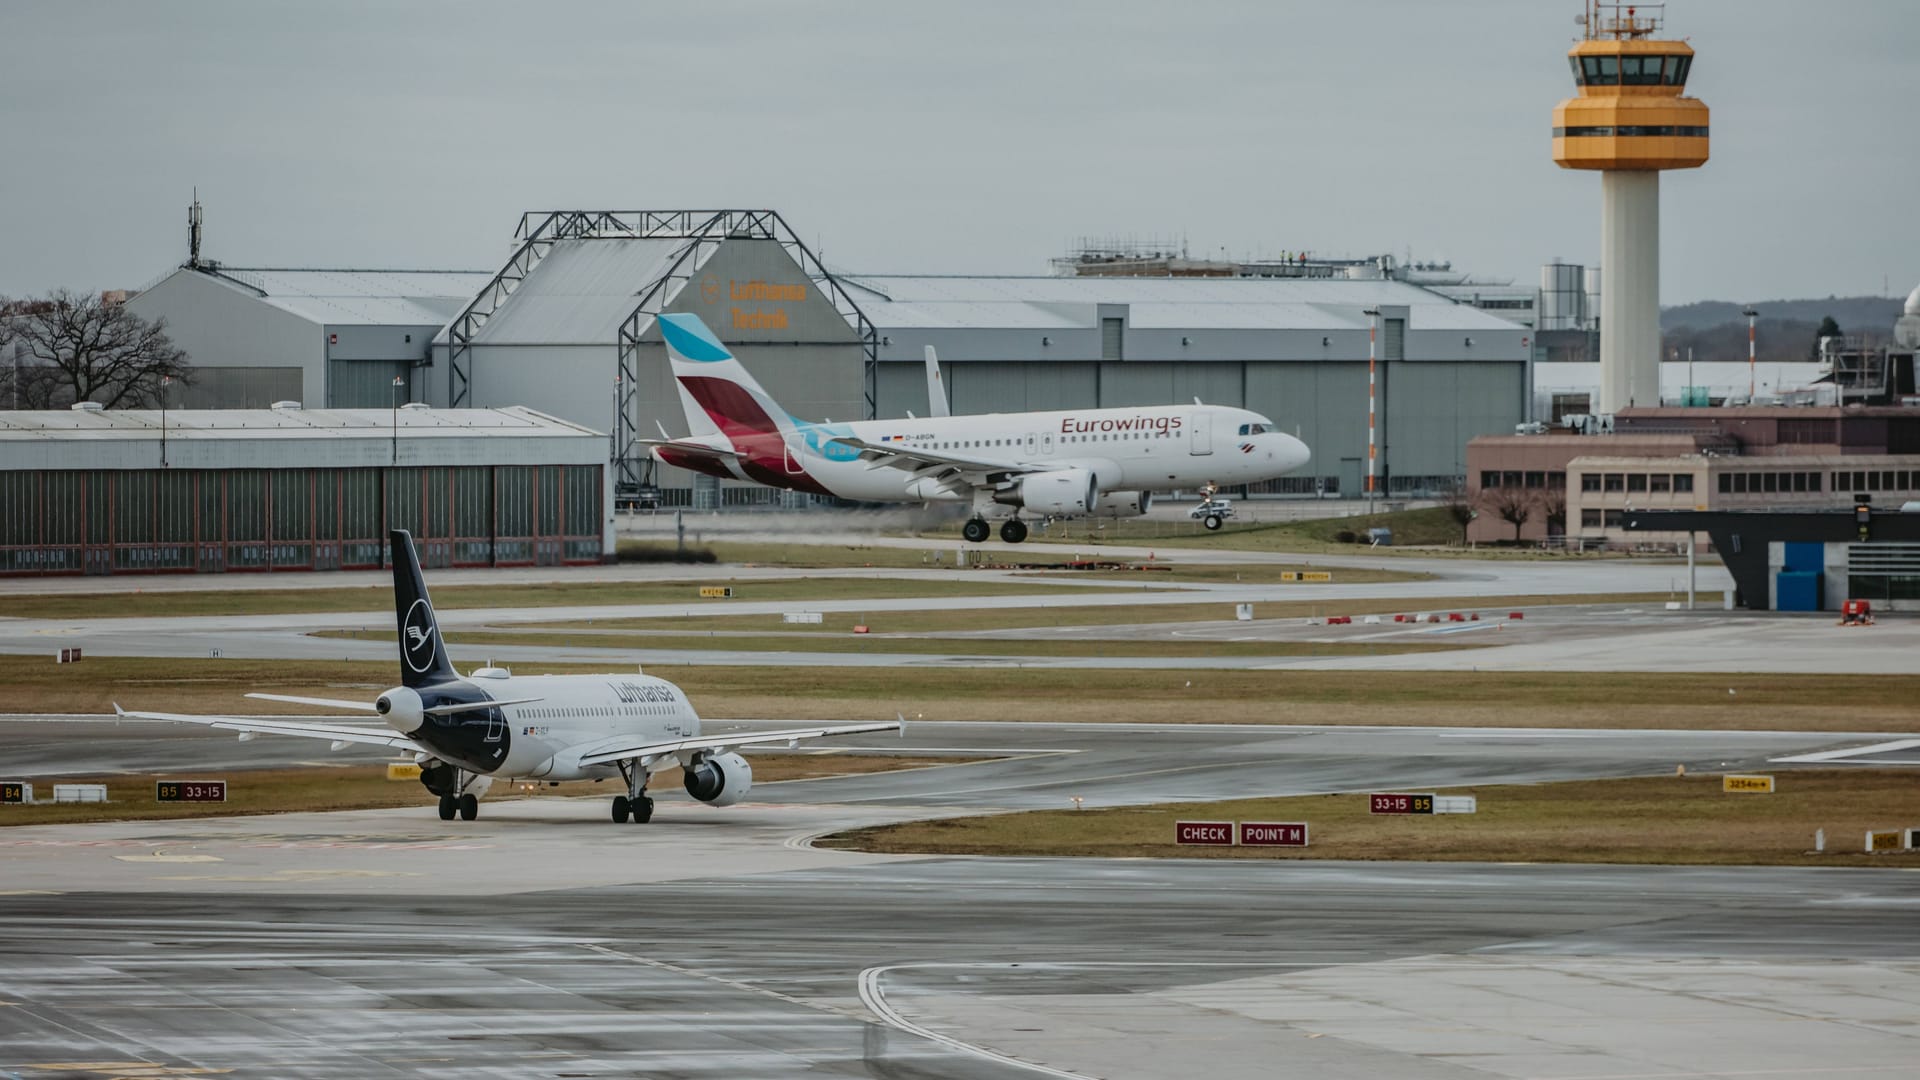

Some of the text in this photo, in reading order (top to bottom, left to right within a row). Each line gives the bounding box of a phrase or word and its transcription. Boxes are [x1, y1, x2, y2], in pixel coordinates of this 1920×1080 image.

[729, 279, 806, 302] Lufthansa
[731, 307, 789, 330] Technik
[1061, 415, 1182, 434] Eurowings
[607, 681, 676, 703] Lufthansa
[5, 787, 20, 799] B4
[161, 786, 220, 798] B5 33-15
[1375, 798, 1430, 810] 33-15 B5
[1183, 827, 1226, 840] CHECK
[1246, 828, 1300, 841] POINT M
